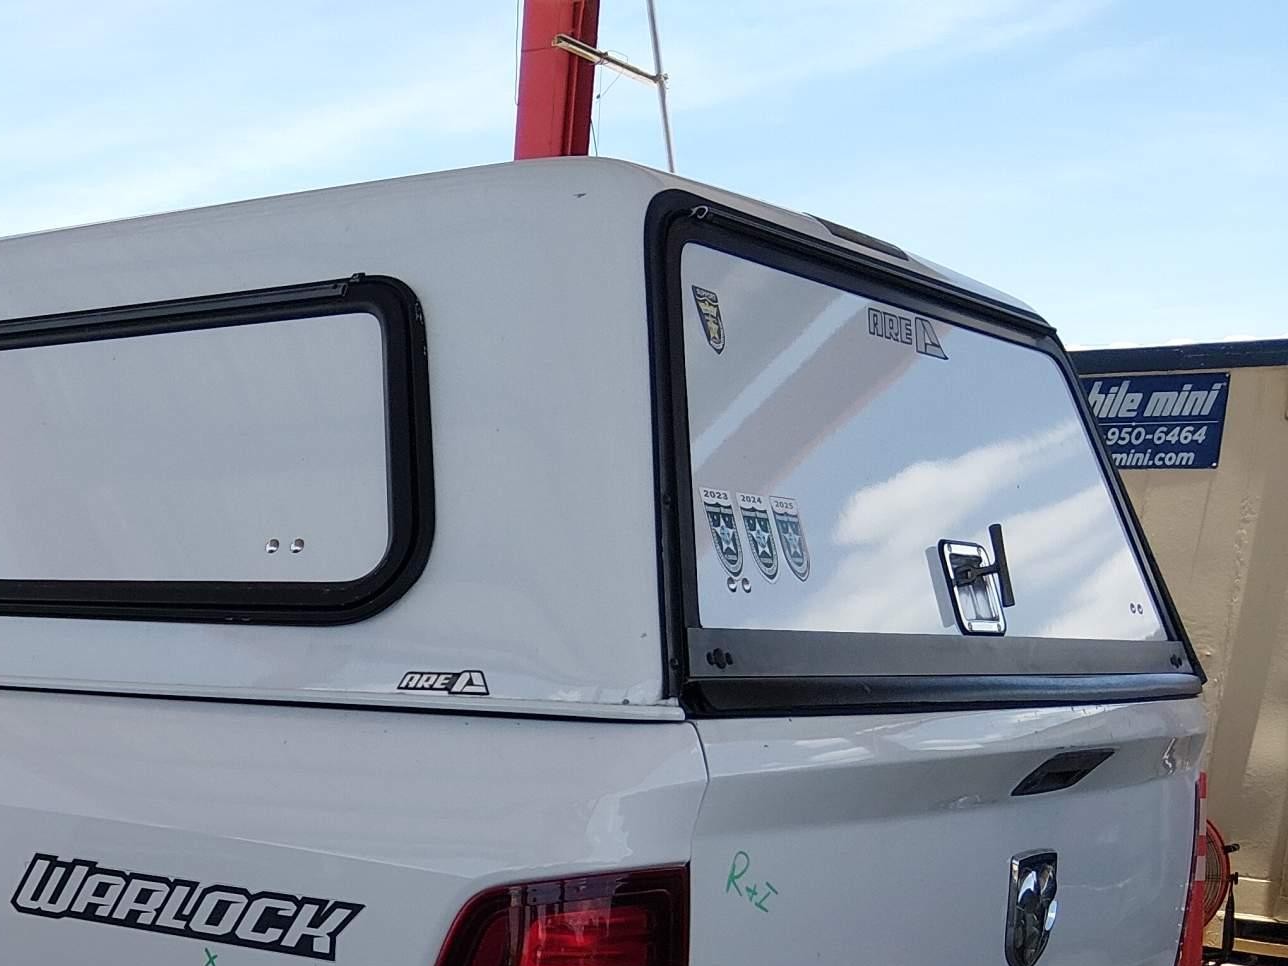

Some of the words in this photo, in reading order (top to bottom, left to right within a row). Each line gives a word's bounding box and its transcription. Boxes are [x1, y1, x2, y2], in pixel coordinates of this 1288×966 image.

[1143, 382, 1223, 417] mini
[703, 489, 729, 500] 2023
[740, 494, 763, 505] 2024
[774, 501, 795, 510] 2025
[12, 854, 364, 960] WARLOCK
